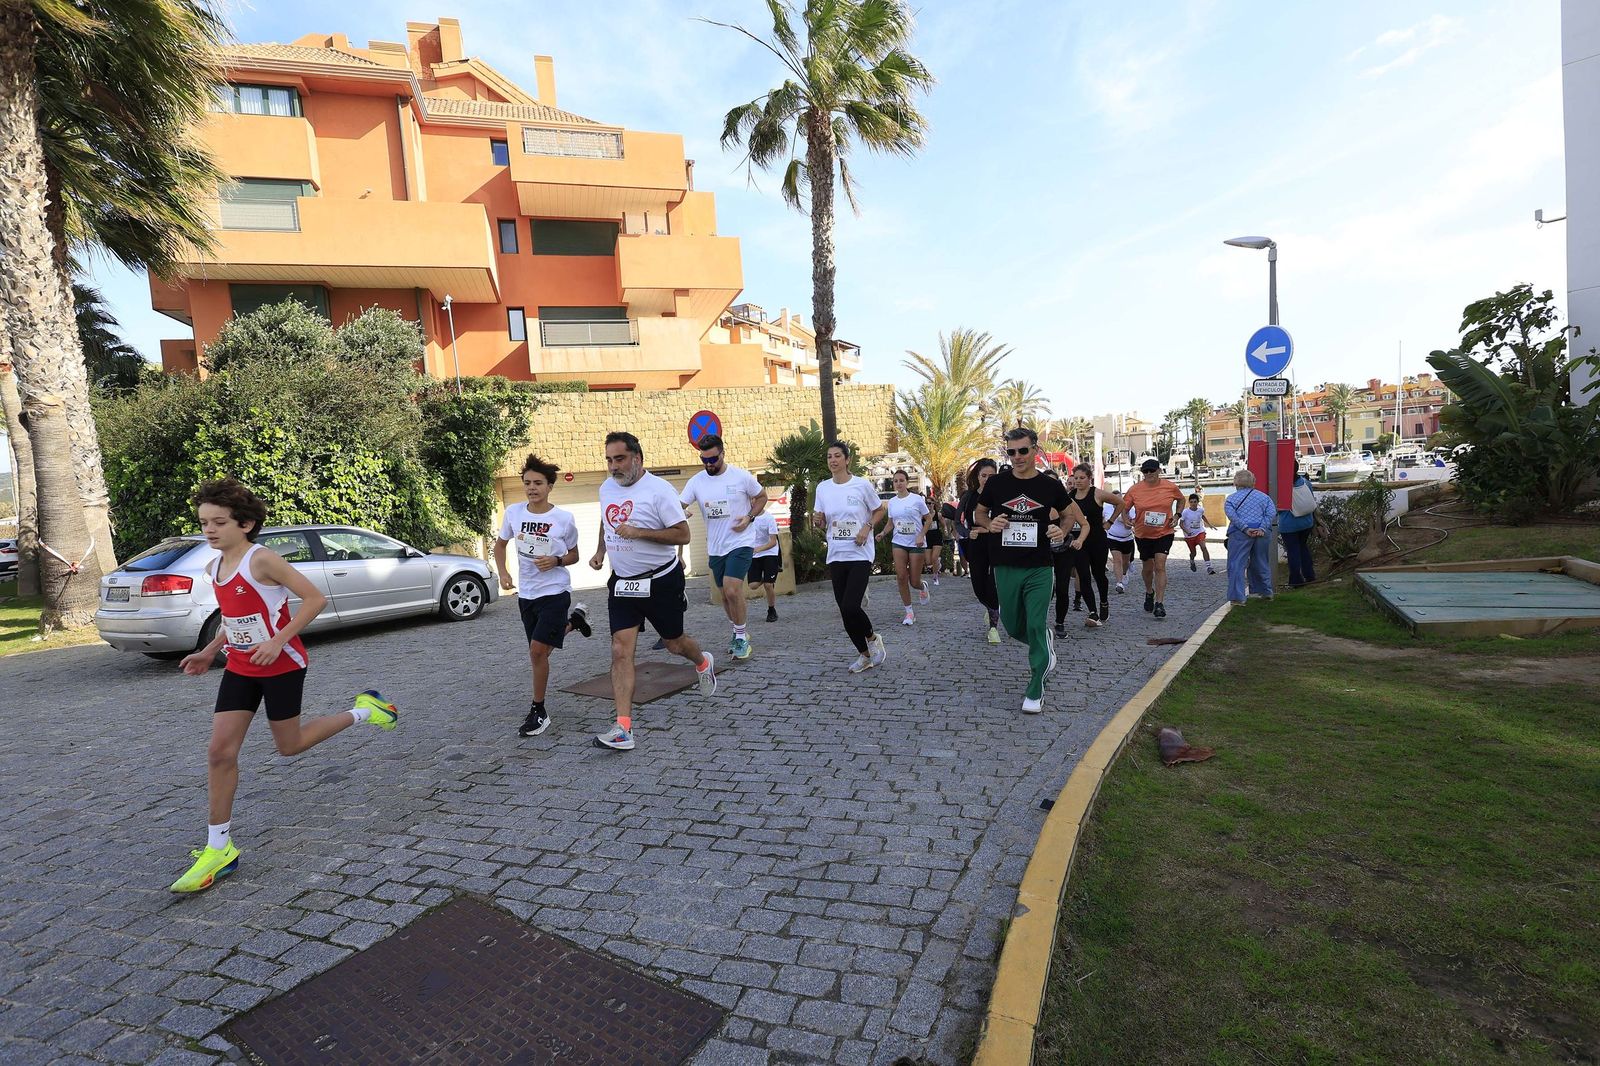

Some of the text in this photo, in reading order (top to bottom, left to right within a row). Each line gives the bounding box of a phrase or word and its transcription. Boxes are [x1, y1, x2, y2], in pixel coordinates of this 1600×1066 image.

[611, 508, 628, 522] 25
[838, 529, 851, 537] 263
[1011, 532, 1027, 541] 135
[528, 545, 535, 554] 2
[624, 581, 640, 591] 202
[236, 616, 256, 624] RUN
